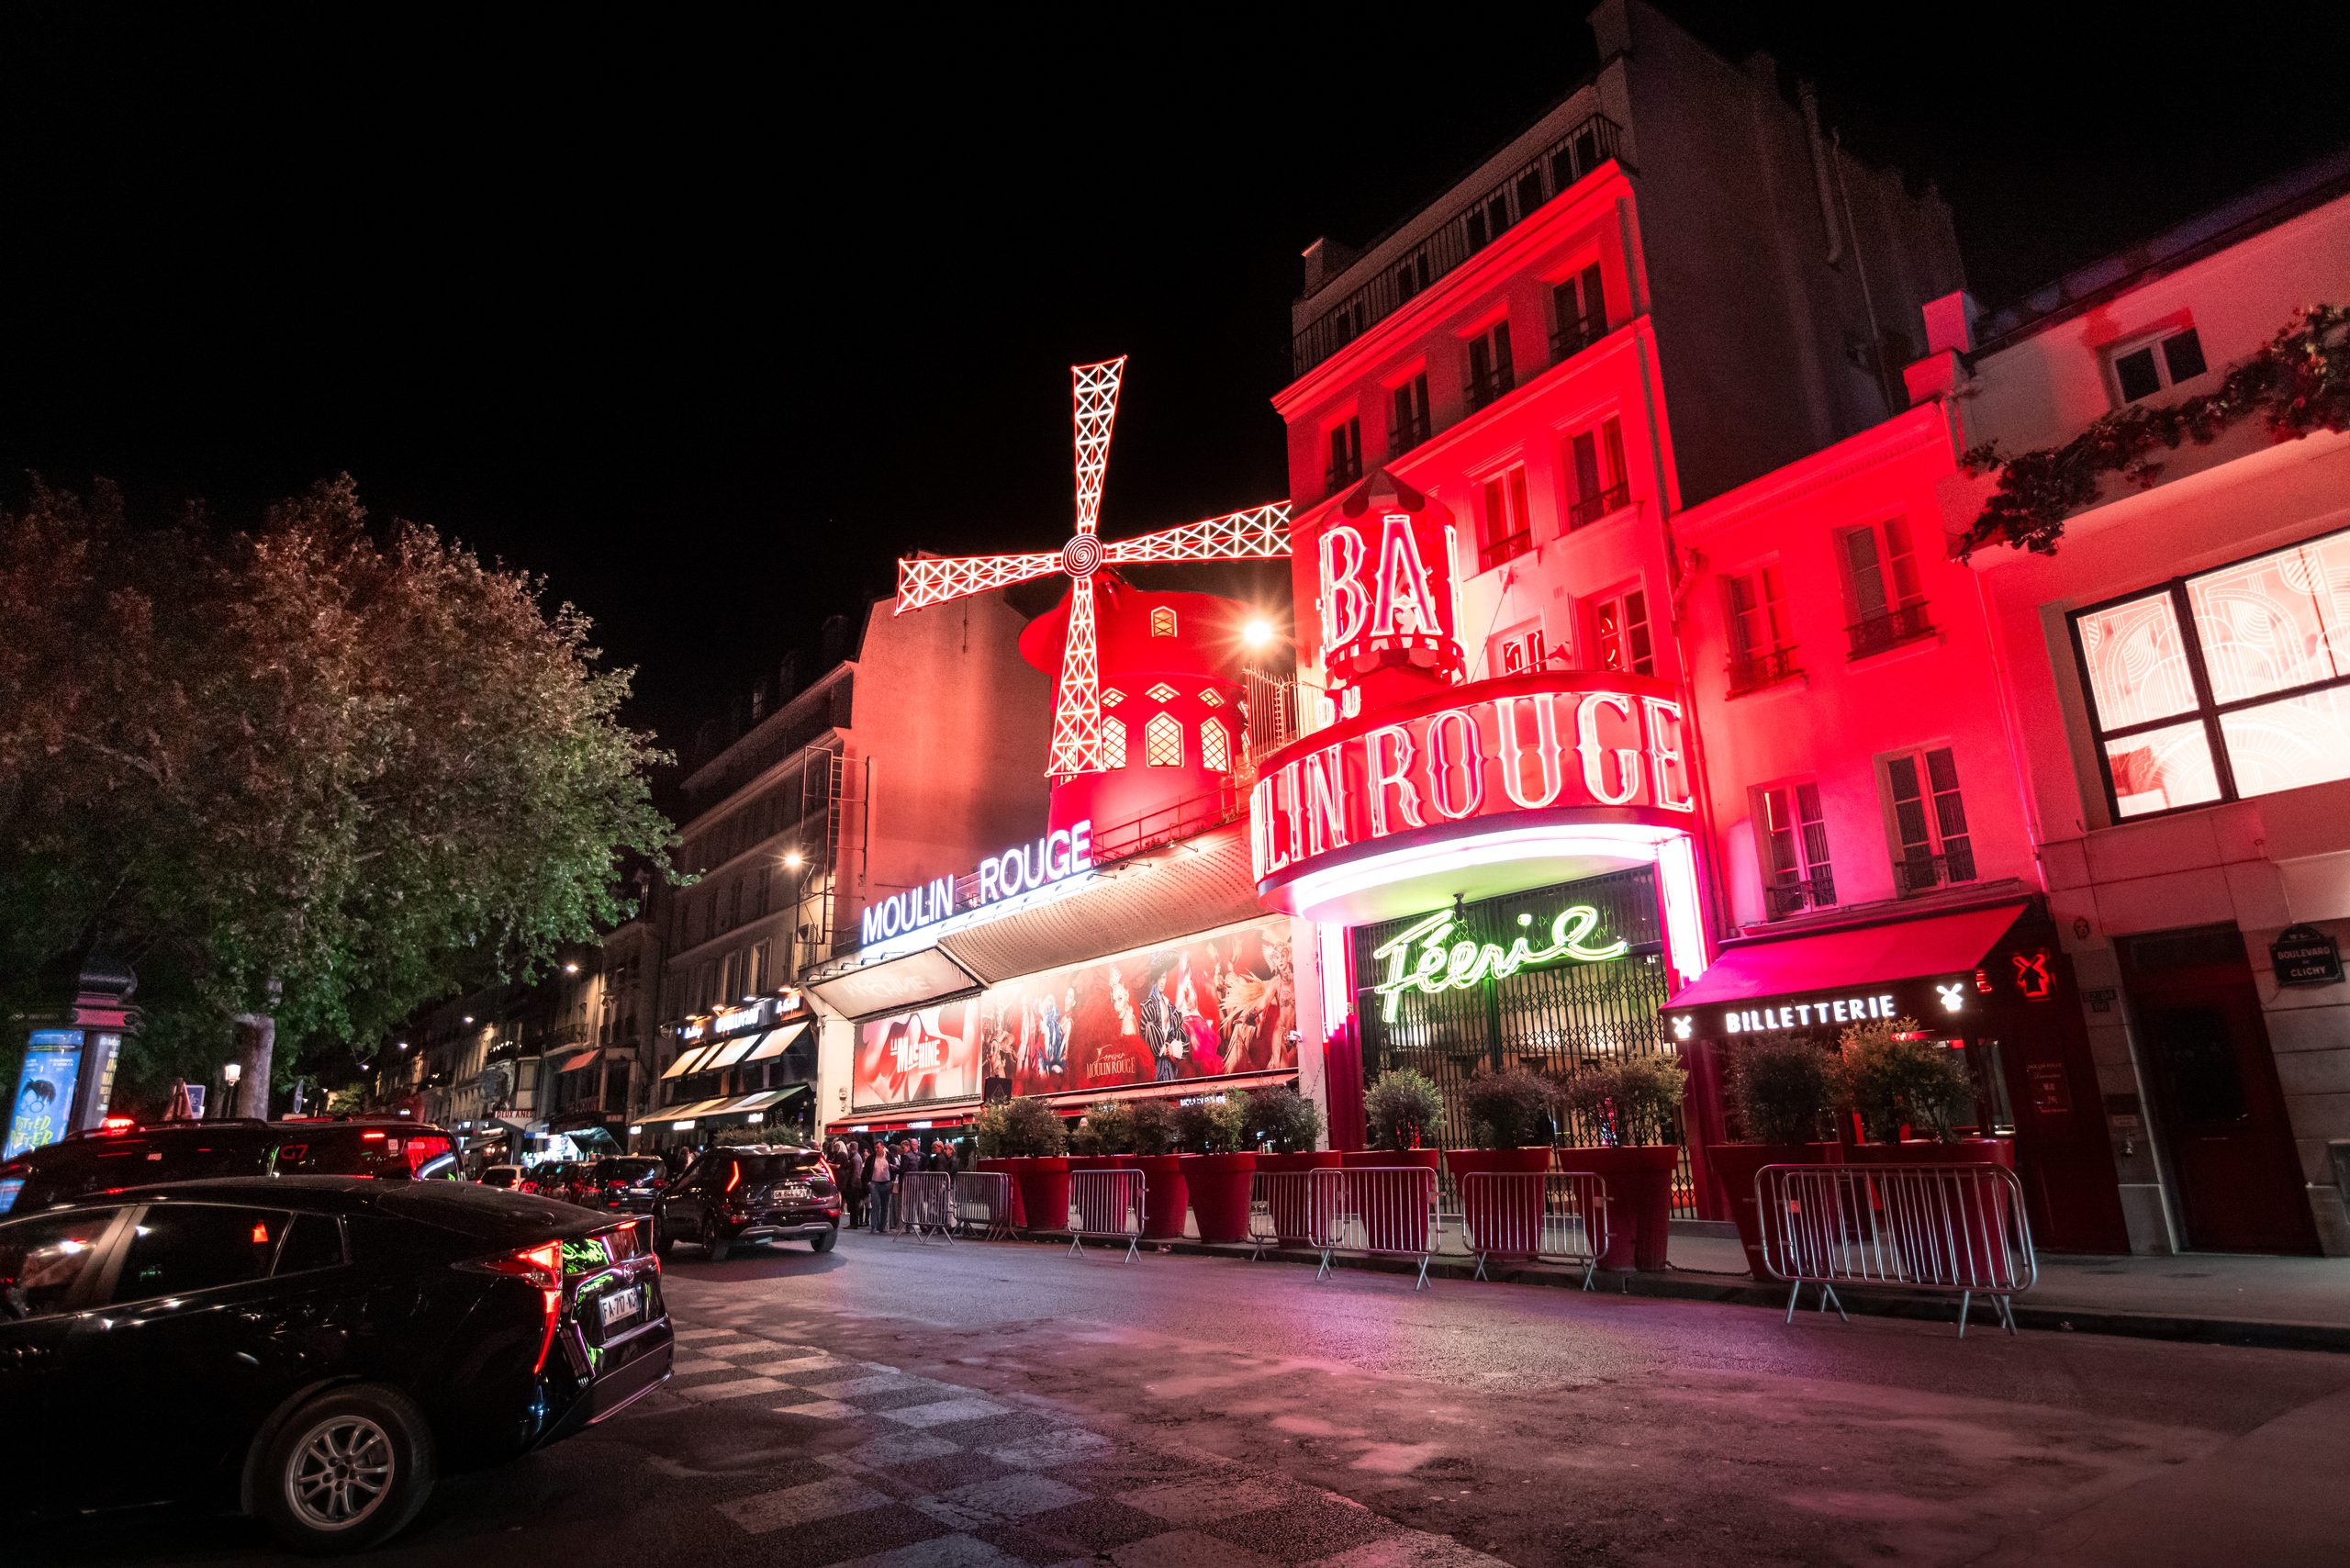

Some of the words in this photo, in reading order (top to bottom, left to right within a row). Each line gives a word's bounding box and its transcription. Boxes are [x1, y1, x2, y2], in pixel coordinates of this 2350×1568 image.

[1316, 685, 1361, 728] DU
[1366, 690, 1695, 838] ROUGE
[862, 874, 954, 945] MOULIN
[979, 819, 1093, 904] ROUGE
[1373, 905, 1631, 1023] Féerie
[2277, 946, 2331, 960] BOULEVARD
[2290, 966, 2326, 977] CLICHY
[1725, 995, 1897, 1034] BILLETTERIE
[1091, 1043, 1126, 1066] Forever
[1086, 1061, 1111, 1079] MOULIN
[1112, 1057, 1136, 1074] ROUGE
[497, 1110, 513, 1118] DEUX
[279, 1144, 309, 1159] G7
